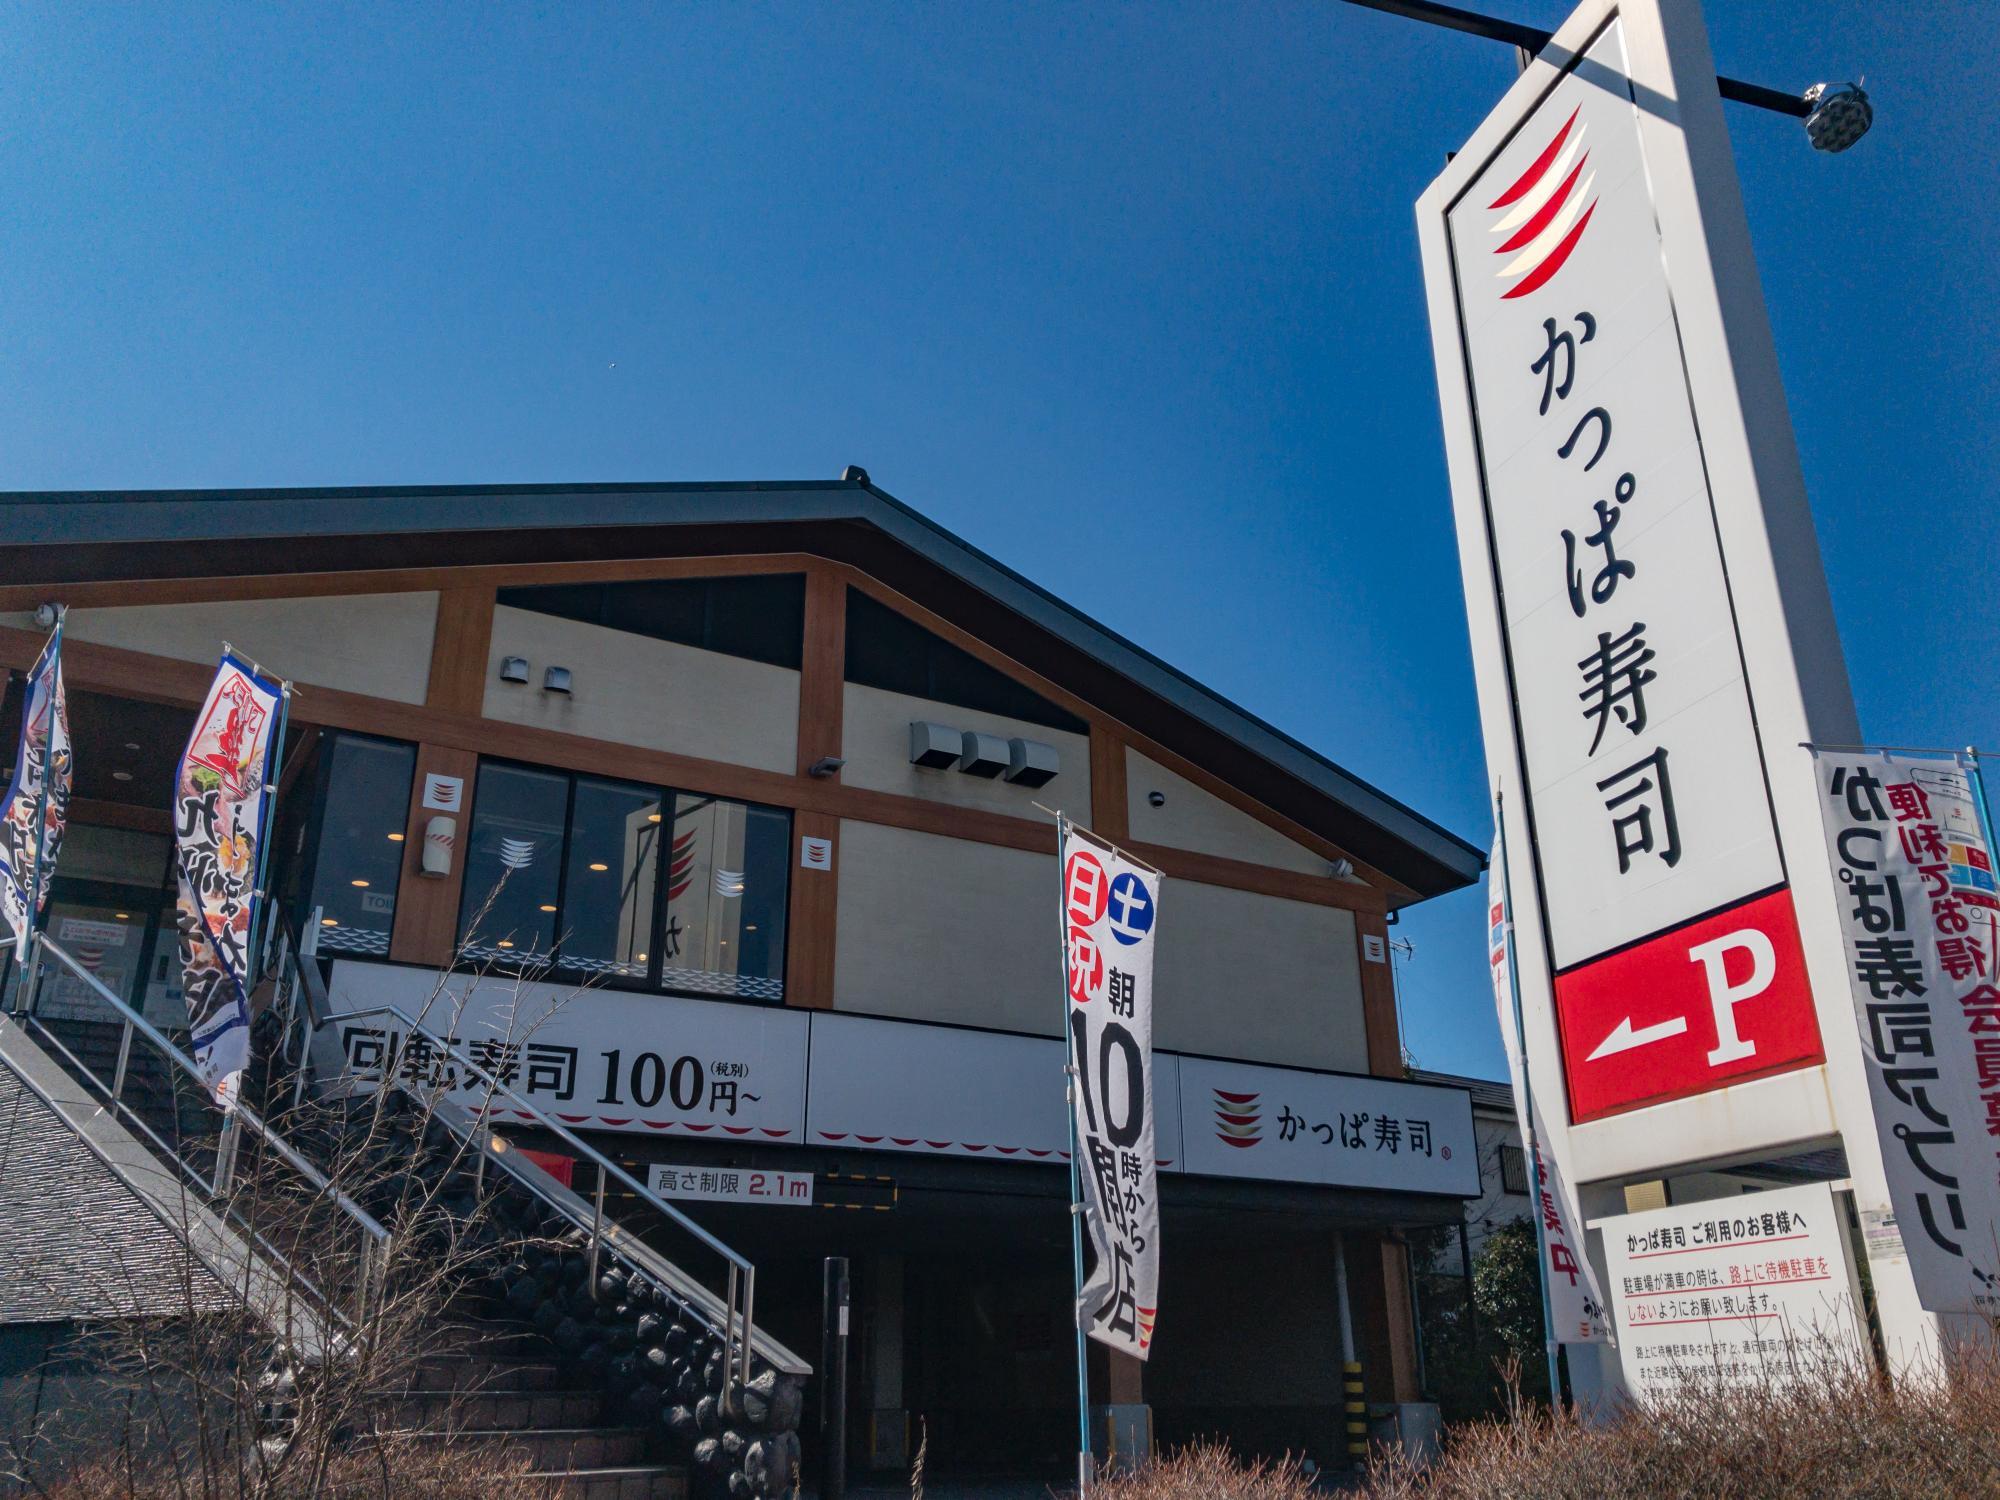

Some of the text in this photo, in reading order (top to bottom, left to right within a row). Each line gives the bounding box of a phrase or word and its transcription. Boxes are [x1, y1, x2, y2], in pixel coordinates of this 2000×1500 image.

[1531, 311, 1682, 875] かっぱ寿司
[1110, 877, 1147, 939] 土
[1689, 928, 1777, 1067] P
[343, 1027, 578, 1100] 回転寿司
[1277, 1105, 1433, 1157] かっぱ寿司
[658, 1170, 809, 1198] 高さ制限 2.1m
[1627, 1211, 1808, 1253] かっぱ寿司 ご利用のお客様へ
